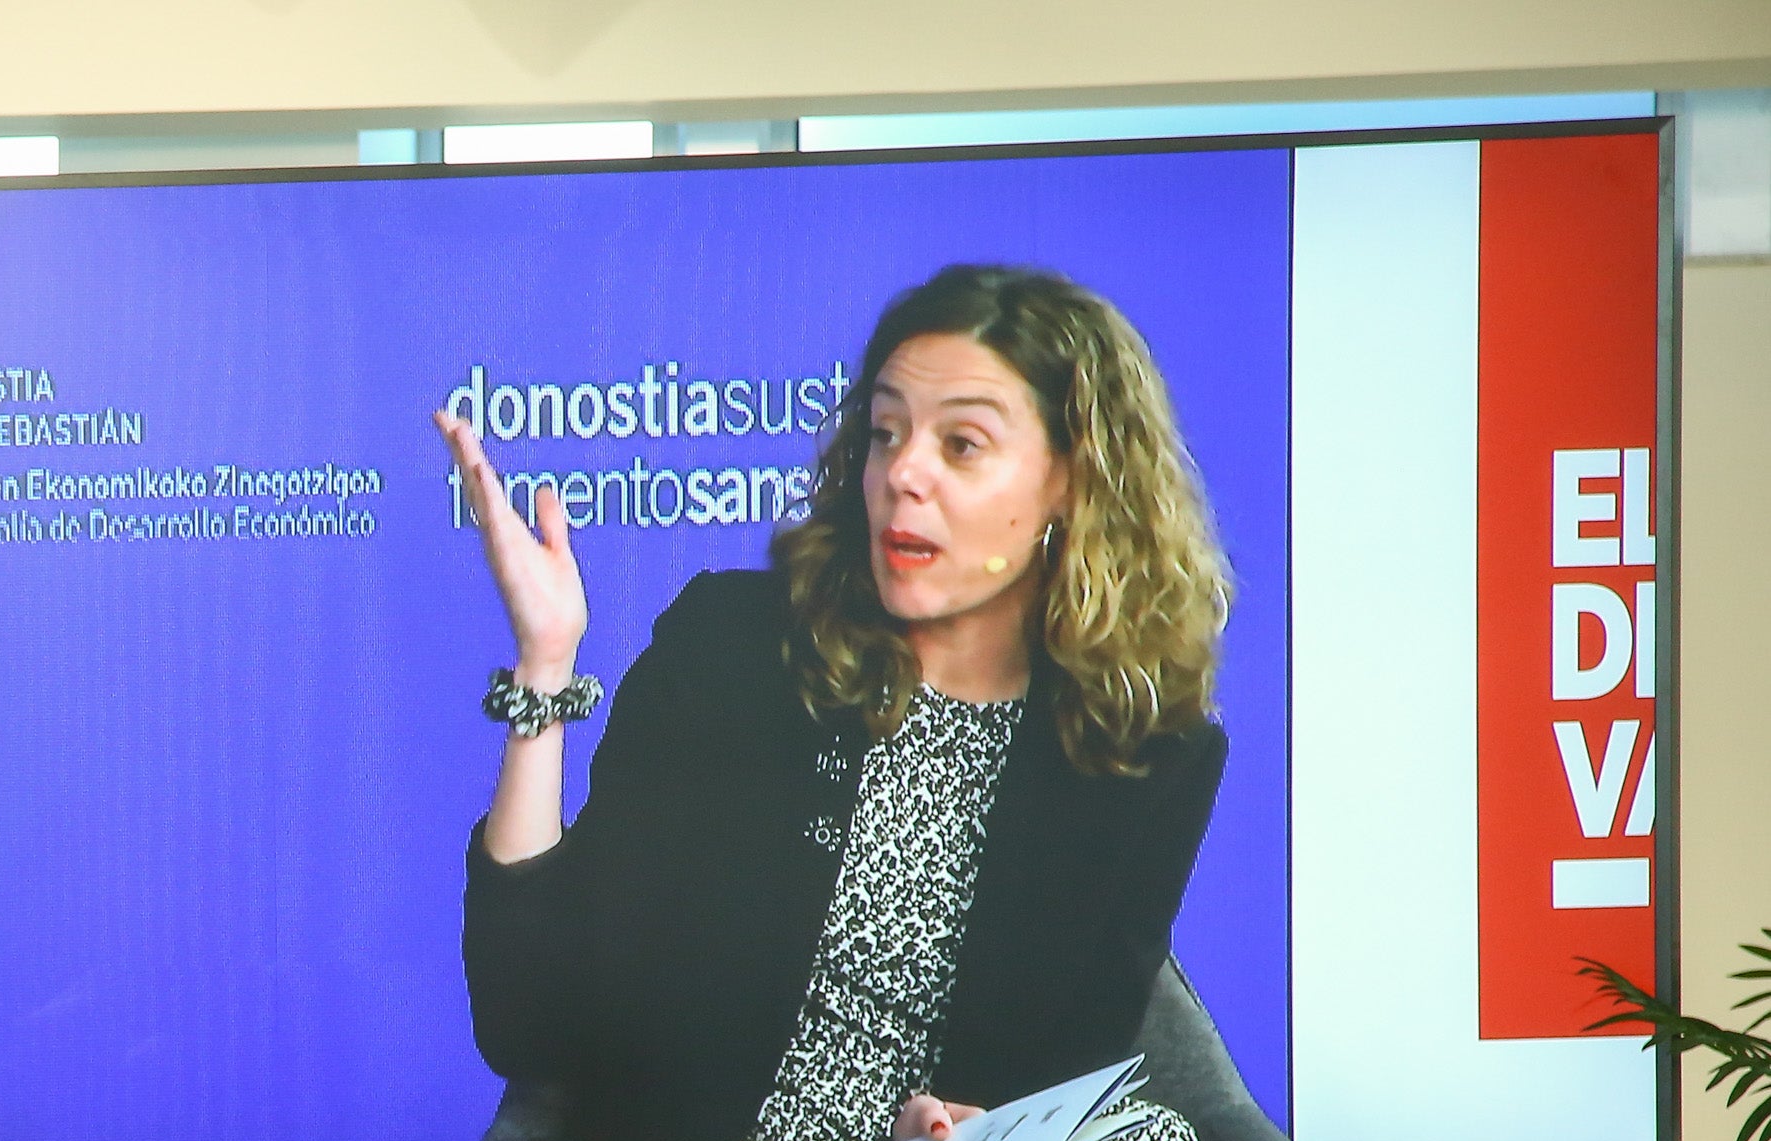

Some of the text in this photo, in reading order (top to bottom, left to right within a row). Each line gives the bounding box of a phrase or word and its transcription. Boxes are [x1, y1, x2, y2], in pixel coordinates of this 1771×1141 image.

[26, 466, 208, 500] Ekonomikoko
[49, 510, 81, 544] de
[89, 507, 226, 543] Desarrollo
[233, 503, 377, 538] Económico
